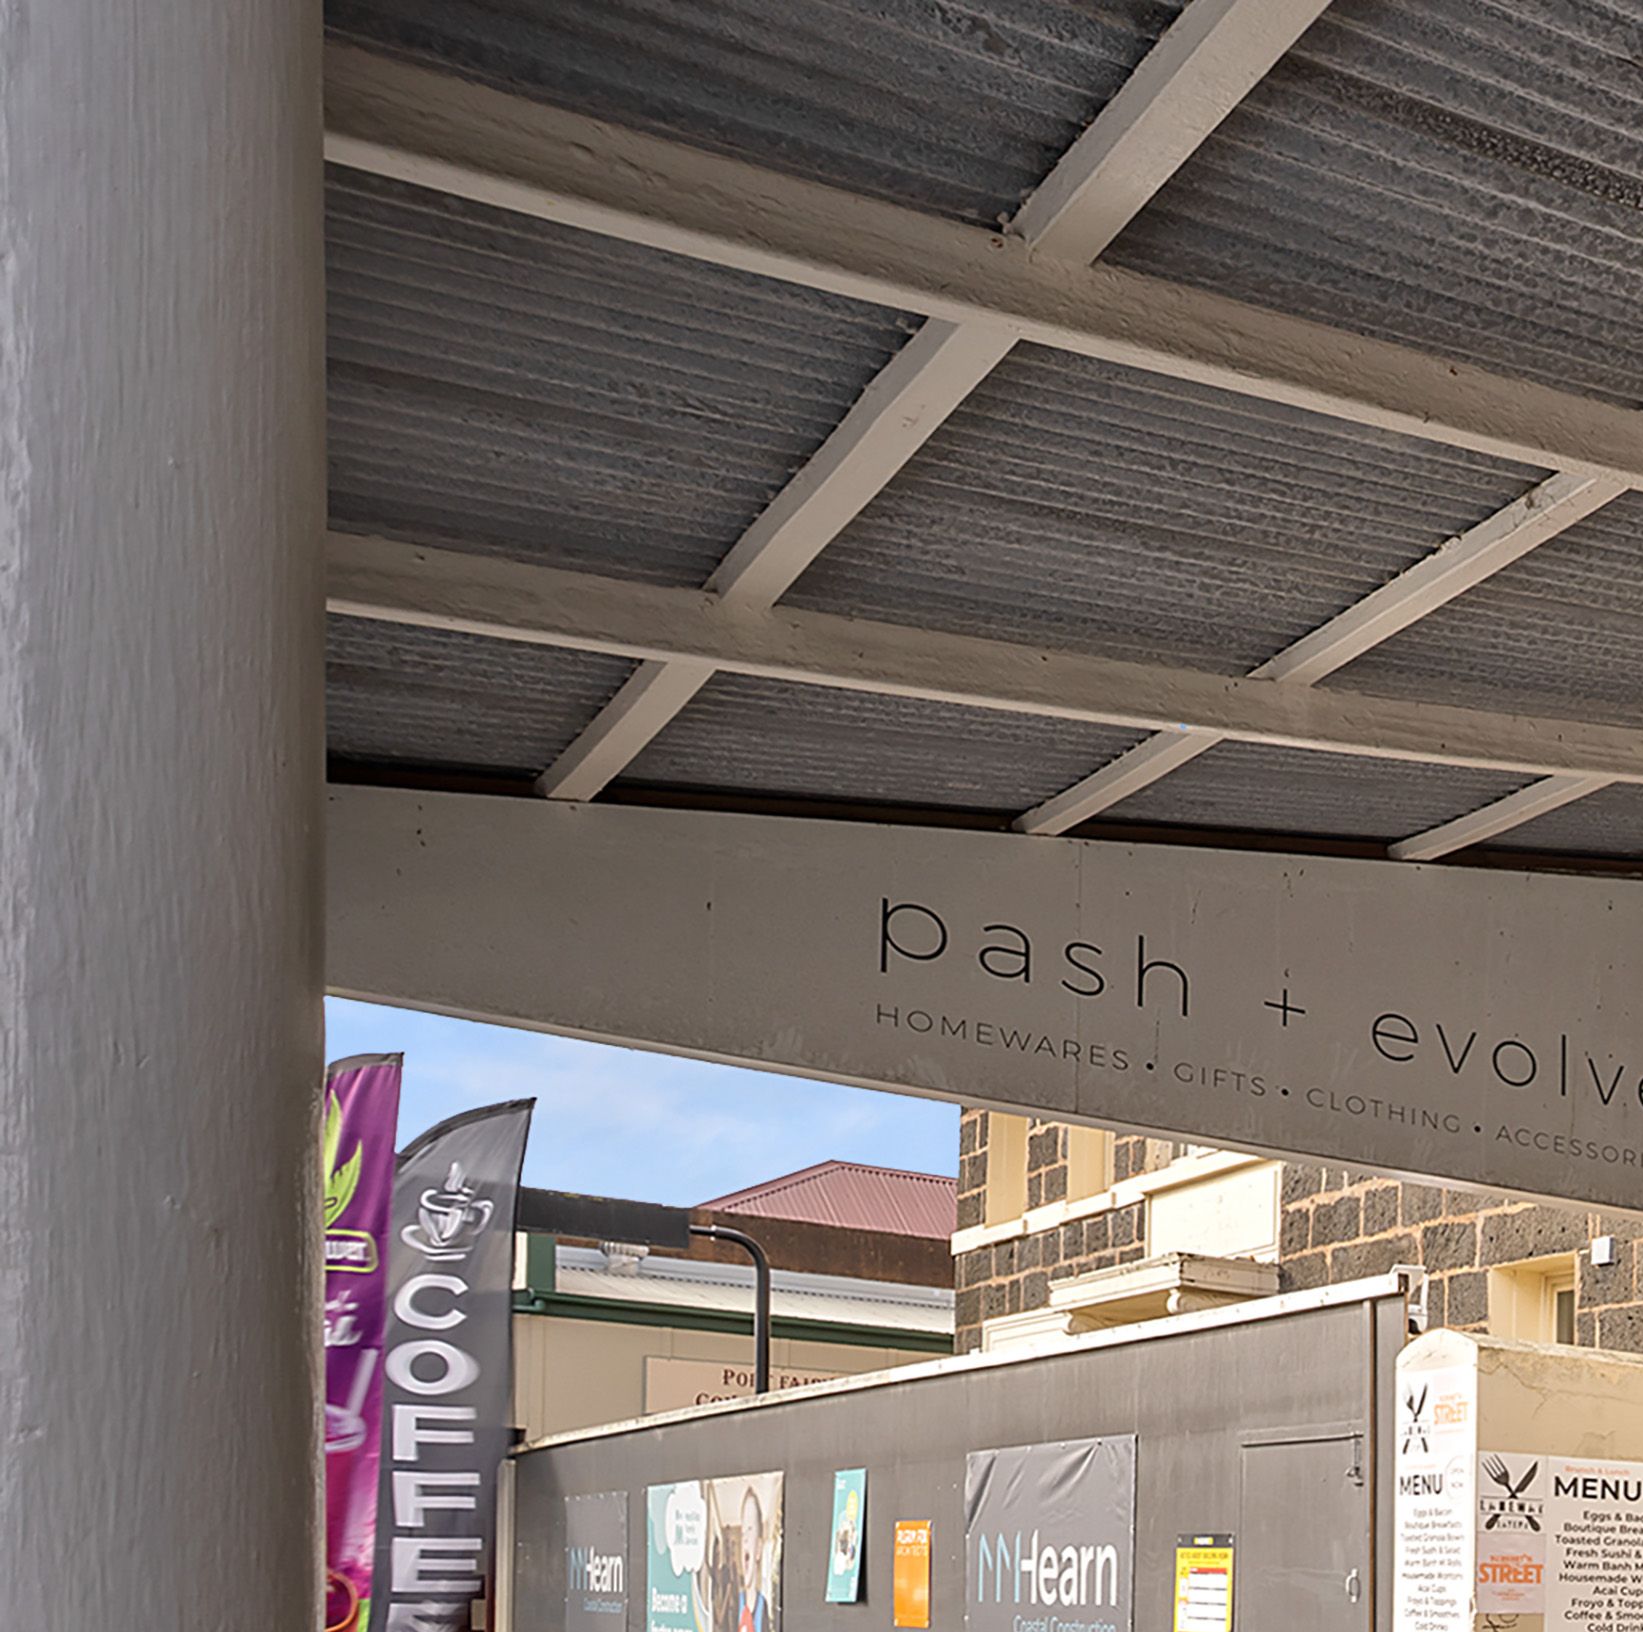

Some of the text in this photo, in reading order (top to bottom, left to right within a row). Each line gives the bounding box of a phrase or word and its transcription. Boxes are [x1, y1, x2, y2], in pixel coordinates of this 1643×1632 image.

[880, 898, 1189, 1017] pash
[1264, 988, 1306, 1027] +
[876, 1003, 1129, 1073] HOMEWARES
[1173, 1061, 1267, 1099] GIFTS
[1306, 1087, 1461, 1136] CLOTHING
[1400, 1473, 1443, 1496] MENU
[1554, 1475, 1642, 1501] MENU
[1583, 1511, 1612, 1523] Eggs
[1614, 1512, 1622, 1521] &
[1563, 1522, 1616, 1535] Boutique
[1555, 1535, 1601, 1545] Toasted
[1566, 1548, 1598, 1558] Fresh
[1601, 1549, 1632, 1559] Sushi
[1634, 1550, 1642, 1559] &
[1563, 1560, 1599, 1570] Warm
[1602, 1562, 1632, 1571] Banh
[1479, 1562, 1544, 1584] STREET
[1559, 1573, 1628, 1583] Housemade
[1592, 1586, 1618, 1595] Acai
[1571, 1598, 1604, 1609] Froyo
[1607, 1599, 1614, 1608] &
[1564, 1610, 1602, 1620] Coffee
[1605, 1611, 1613, 1620] &
[1587, 1623, 1613, 1632] Cold
